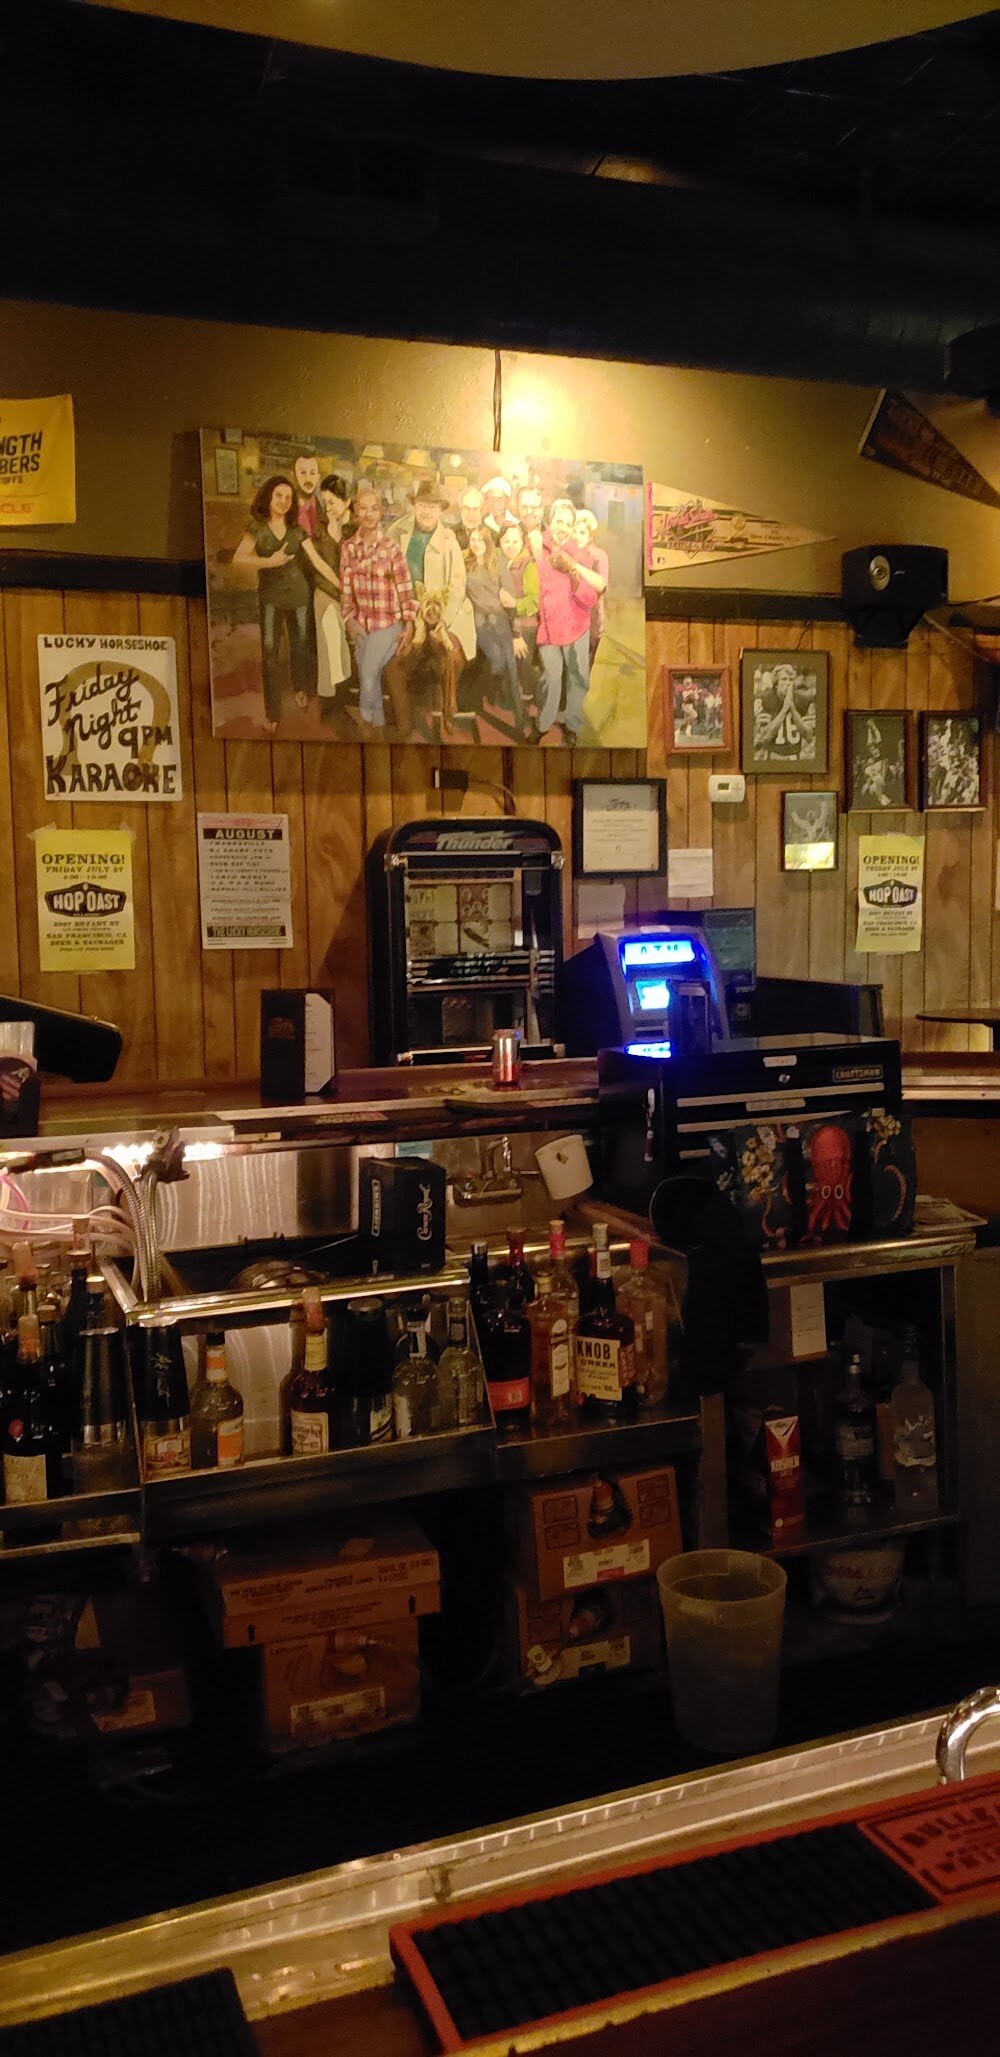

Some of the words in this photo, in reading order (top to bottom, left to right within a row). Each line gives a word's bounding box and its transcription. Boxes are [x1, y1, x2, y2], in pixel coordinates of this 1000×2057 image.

[43, 636, 96, 649] LUCKY
[100, 637, 168, 650] HORSESHOE
[45, 662, 140, 727] Friday
[46, 754, 177, 794] KARAOKE
[215, 828, 275, 839] AUGUST
[435, 830, 514, 851] Thunder
[41, 853, 125, 865] OPENING!
[863, 855, 920, 865] OPENING!
[53, 891, 85, 912] HOP
[86, 891, 121, 912] OAST
[868, 886, 891, 903] HOP
[891, 886, 915, 903] OAST
[576, 1339, 611, 1360] KNOB
